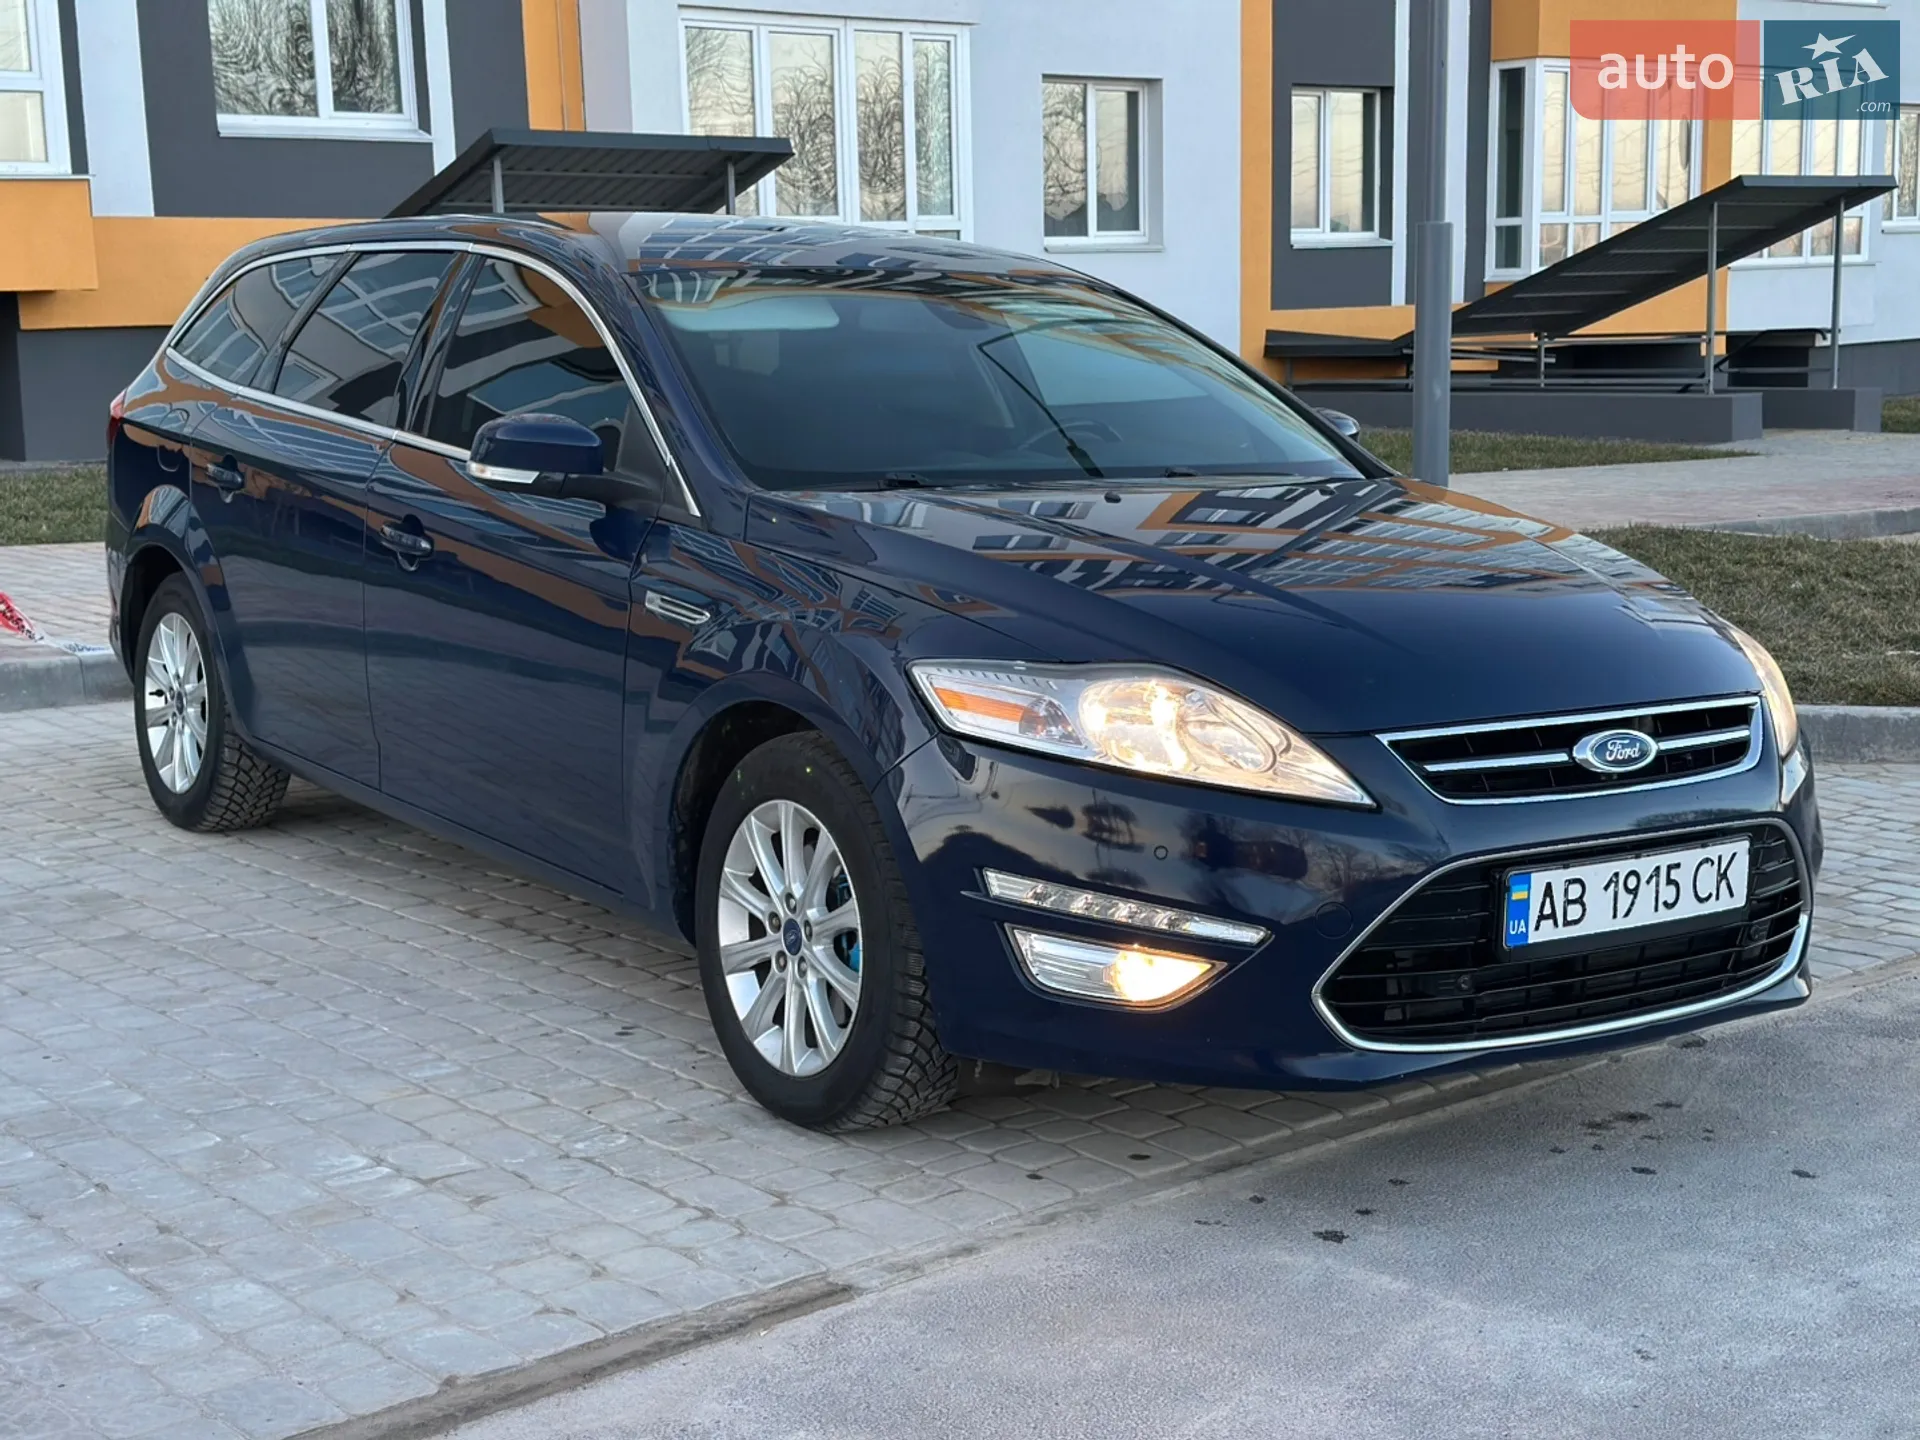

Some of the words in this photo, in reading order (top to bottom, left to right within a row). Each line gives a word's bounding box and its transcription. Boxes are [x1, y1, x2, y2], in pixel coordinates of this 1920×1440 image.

[1606, 739, 1640, 761] Ford
[1534, 878, 1587, 931] AB
[1603, 862, 1681, 919] 1915
[1693, 852, 1737, 903] CK
[1510, 919, 1526, 934] UA
